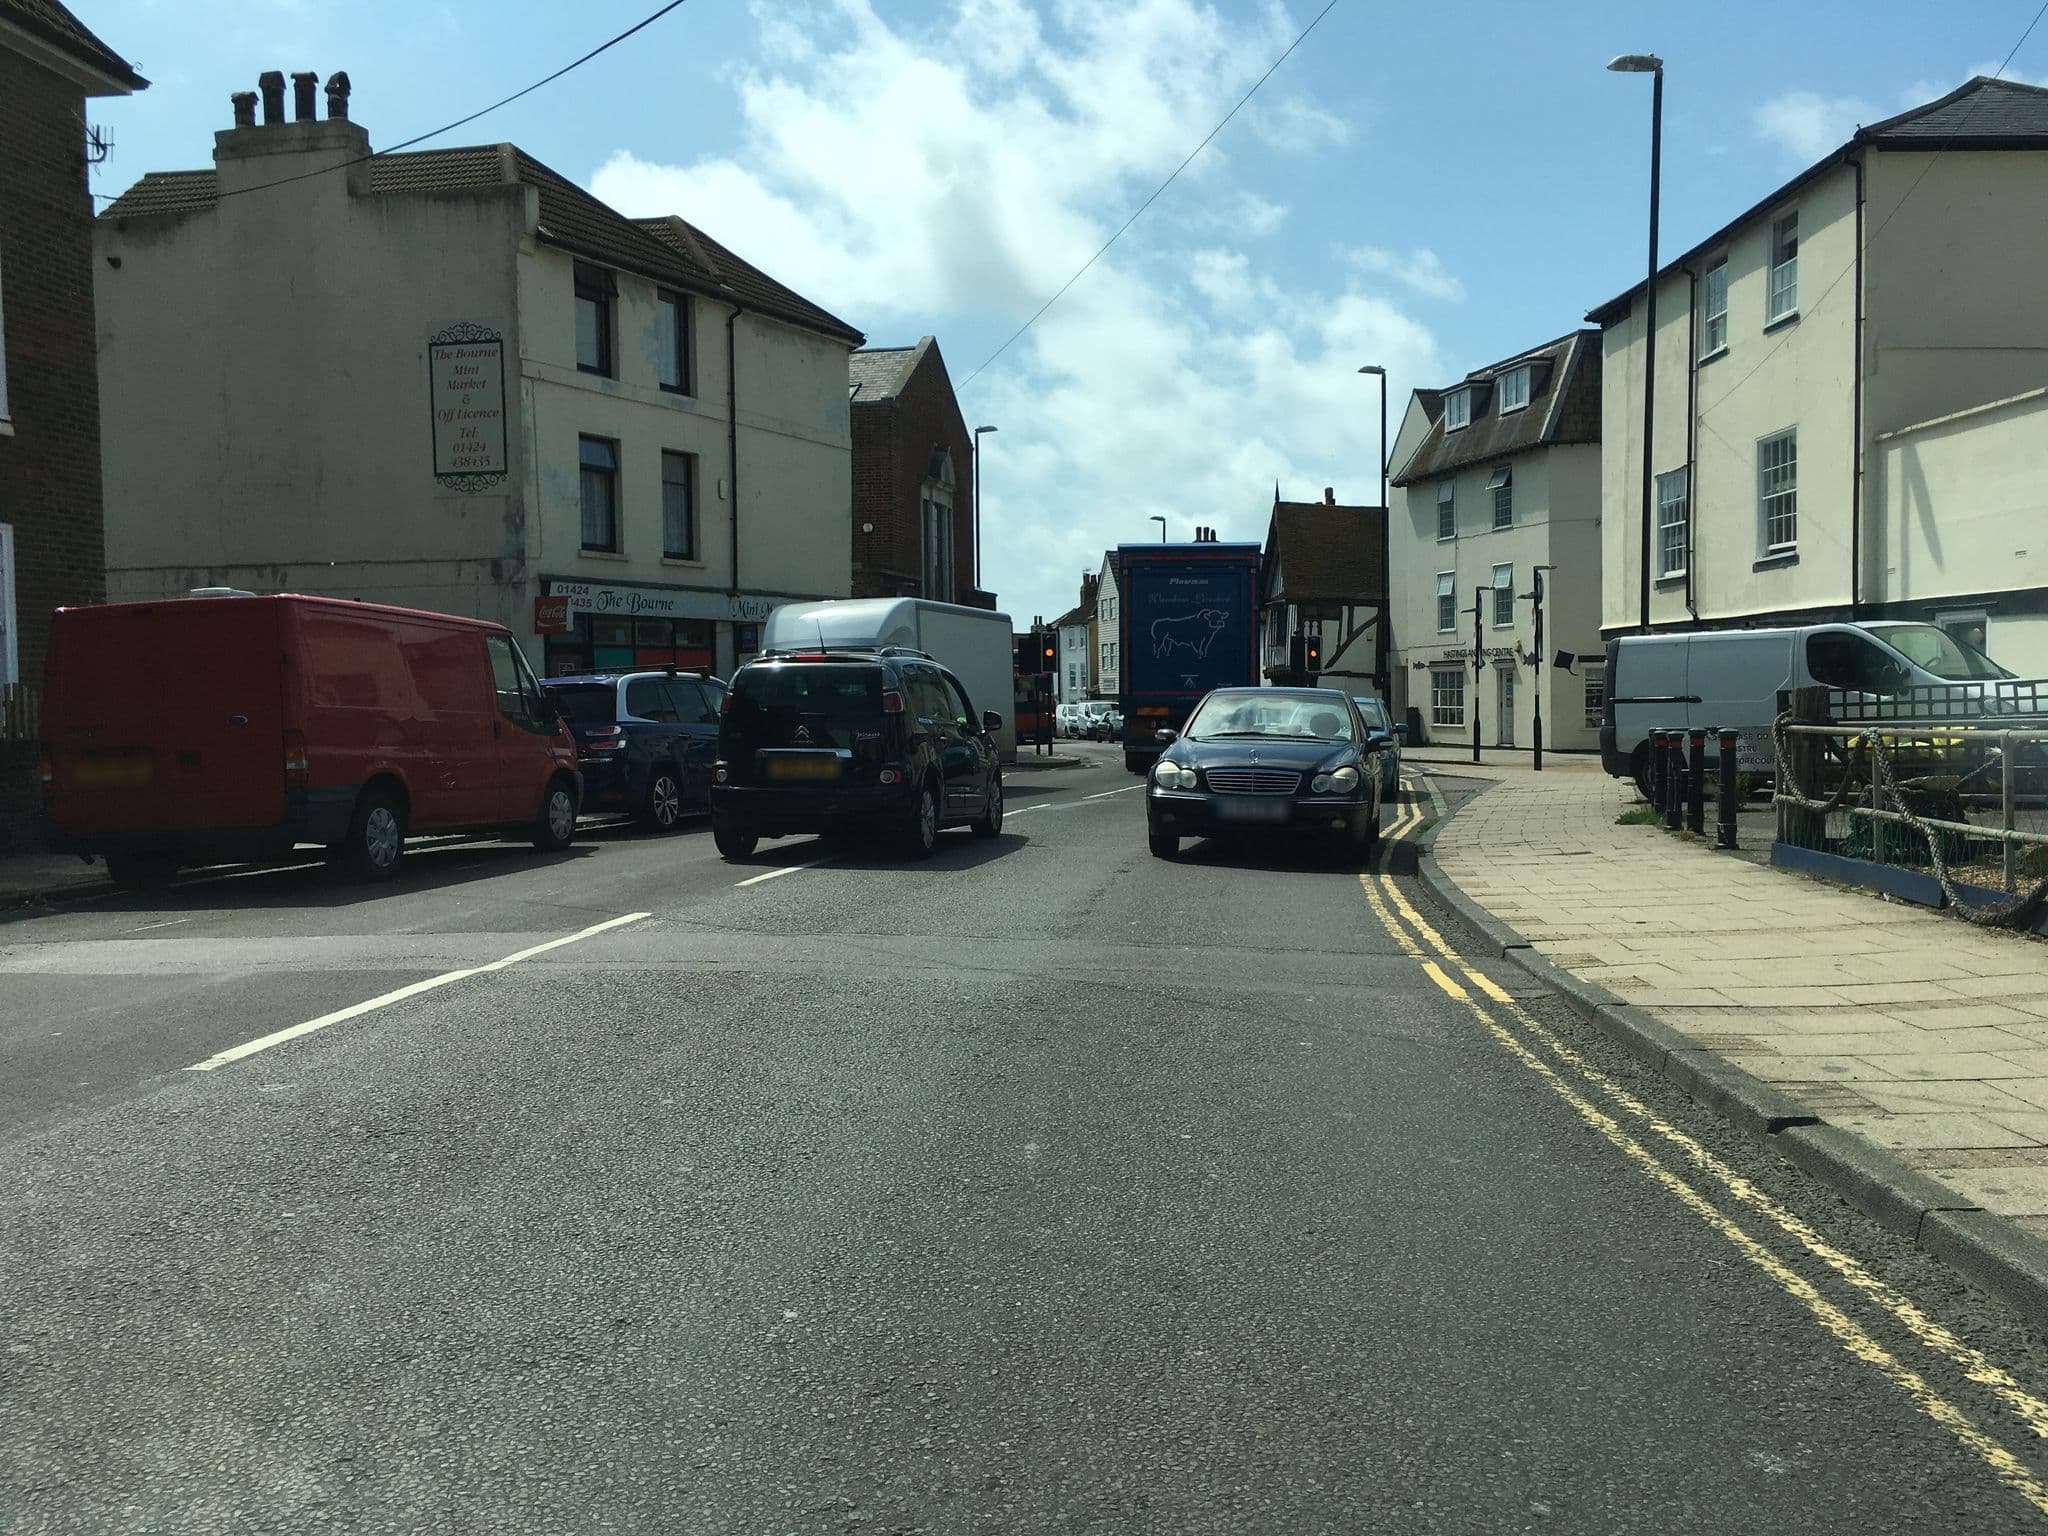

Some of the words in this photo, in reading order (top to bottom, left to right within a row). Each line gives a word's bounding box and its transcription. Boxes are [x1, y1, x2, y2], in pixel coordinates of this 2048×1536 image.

[434, 349, 453, 360] The
[456, 347, 498, 359] Bourne
[455, 365, 480, 376] Mini
[447, 378, 487, 390] Market
[462, 393, 471, 404] &
[438, 407, 455, 424] Off
[457, 408, 499, 420] Licence
[452, 441, 487, 452] 01424
[557, 584, 589, 595] 01424
[597, 590, 623, 611] The
[626, 592, 674, 614] Bourne
[731, 600, 759, 618] Mini
[1491, 647, 1514, 657] CENTRE
